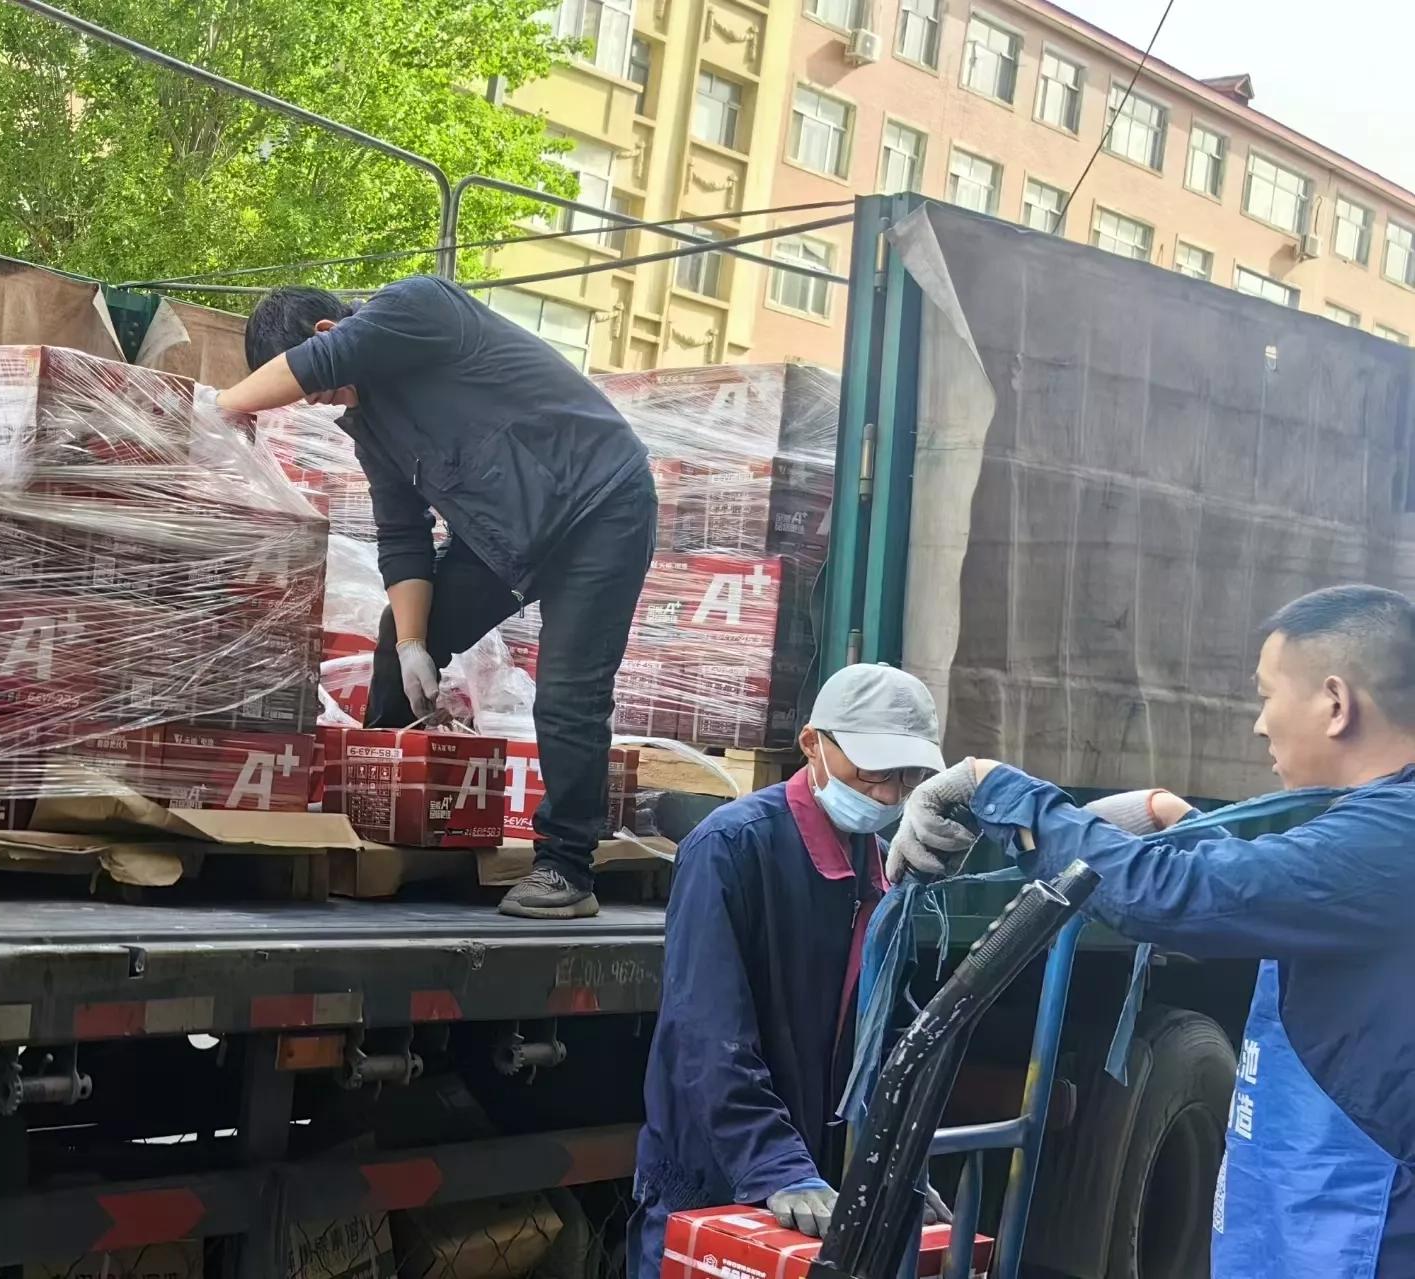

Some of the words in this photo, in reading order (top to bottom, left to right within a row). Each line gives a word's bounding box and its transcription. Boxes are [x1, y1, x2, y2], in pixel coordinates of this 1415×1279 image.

[692, 565, 771, 625] A+
[225, 744, 300, 810] A+
[455, 748, 504, 809] A+
[1228, 1088, 1254, 1140] 造
